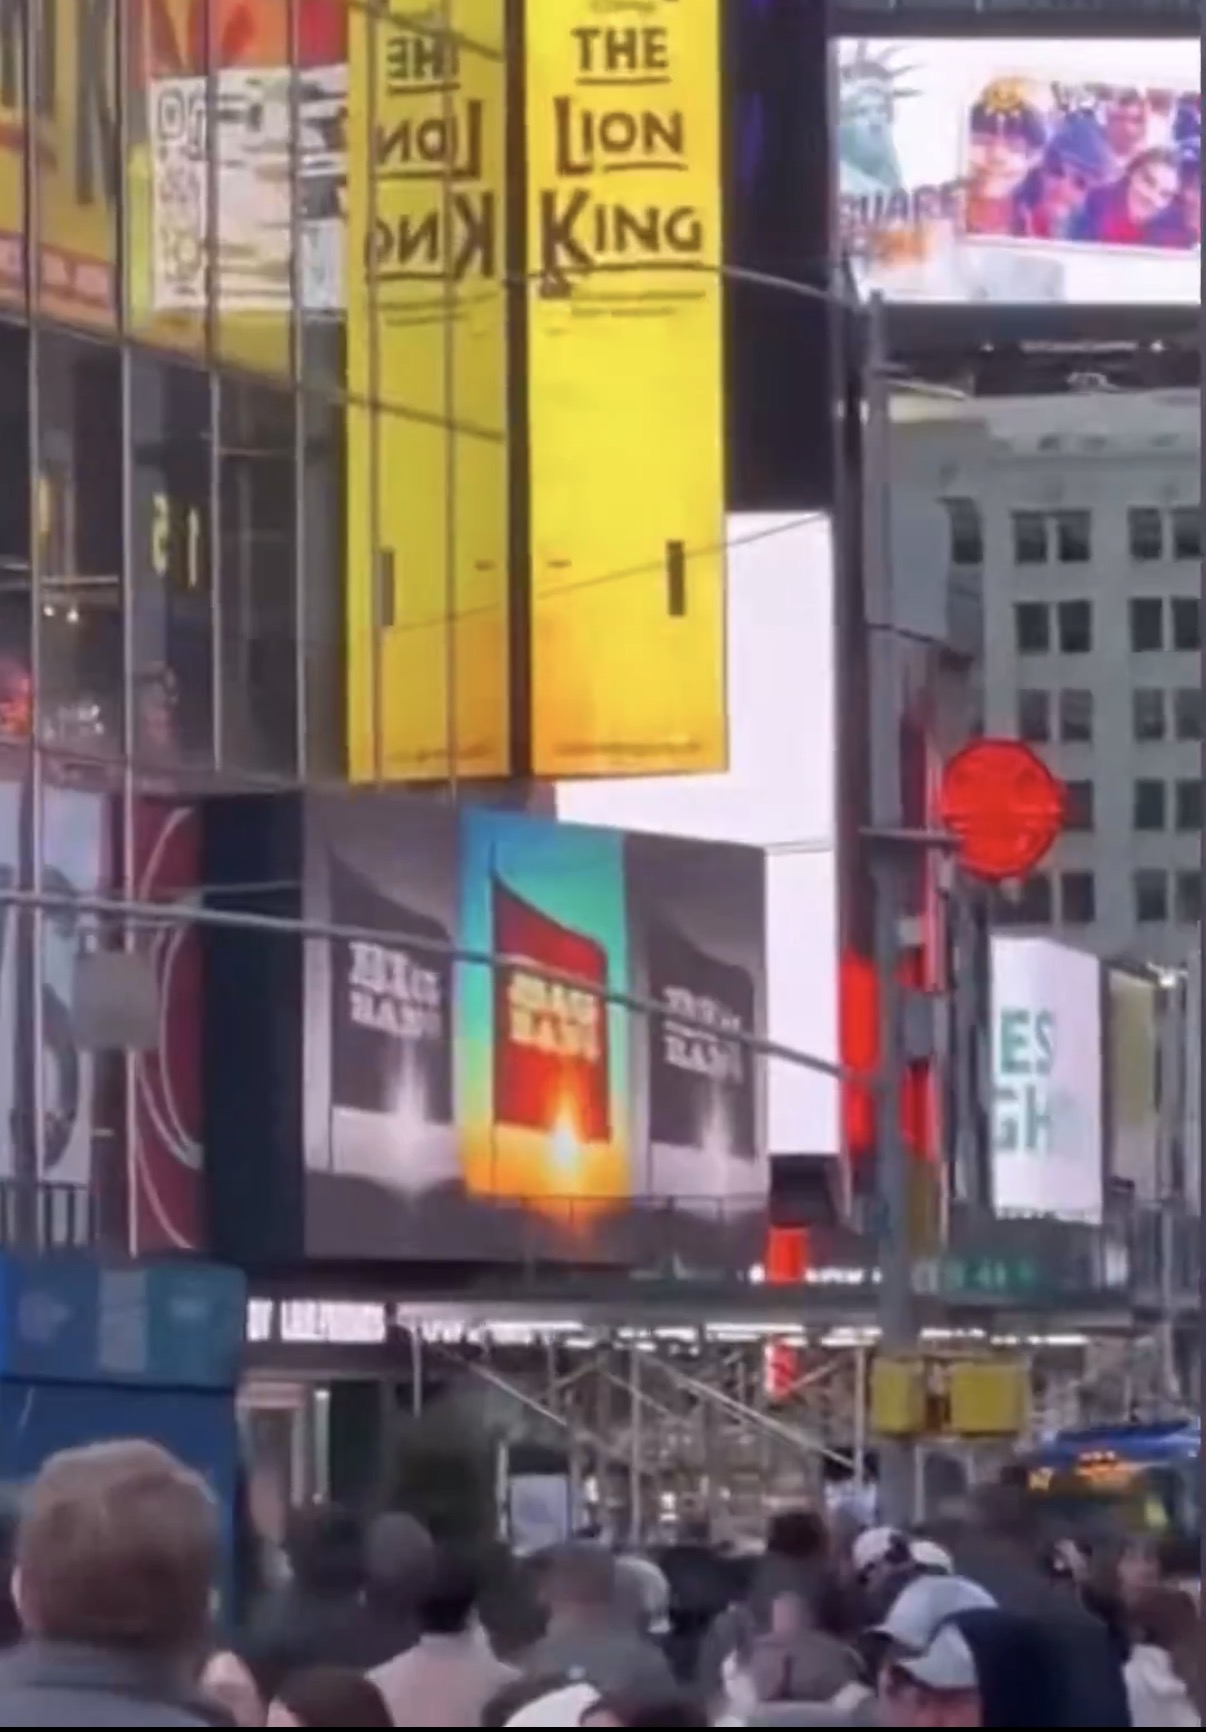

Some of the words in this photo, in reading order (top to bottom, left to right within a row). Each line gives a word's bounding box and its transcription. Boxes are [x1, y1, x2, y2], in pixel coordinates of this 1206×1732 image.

[570, 27, 669, 71] THE
[553, 96, 685, 176] LION
[539, 189, 703, 284] KING
[1000, 1008, 1057, 1076] ES
